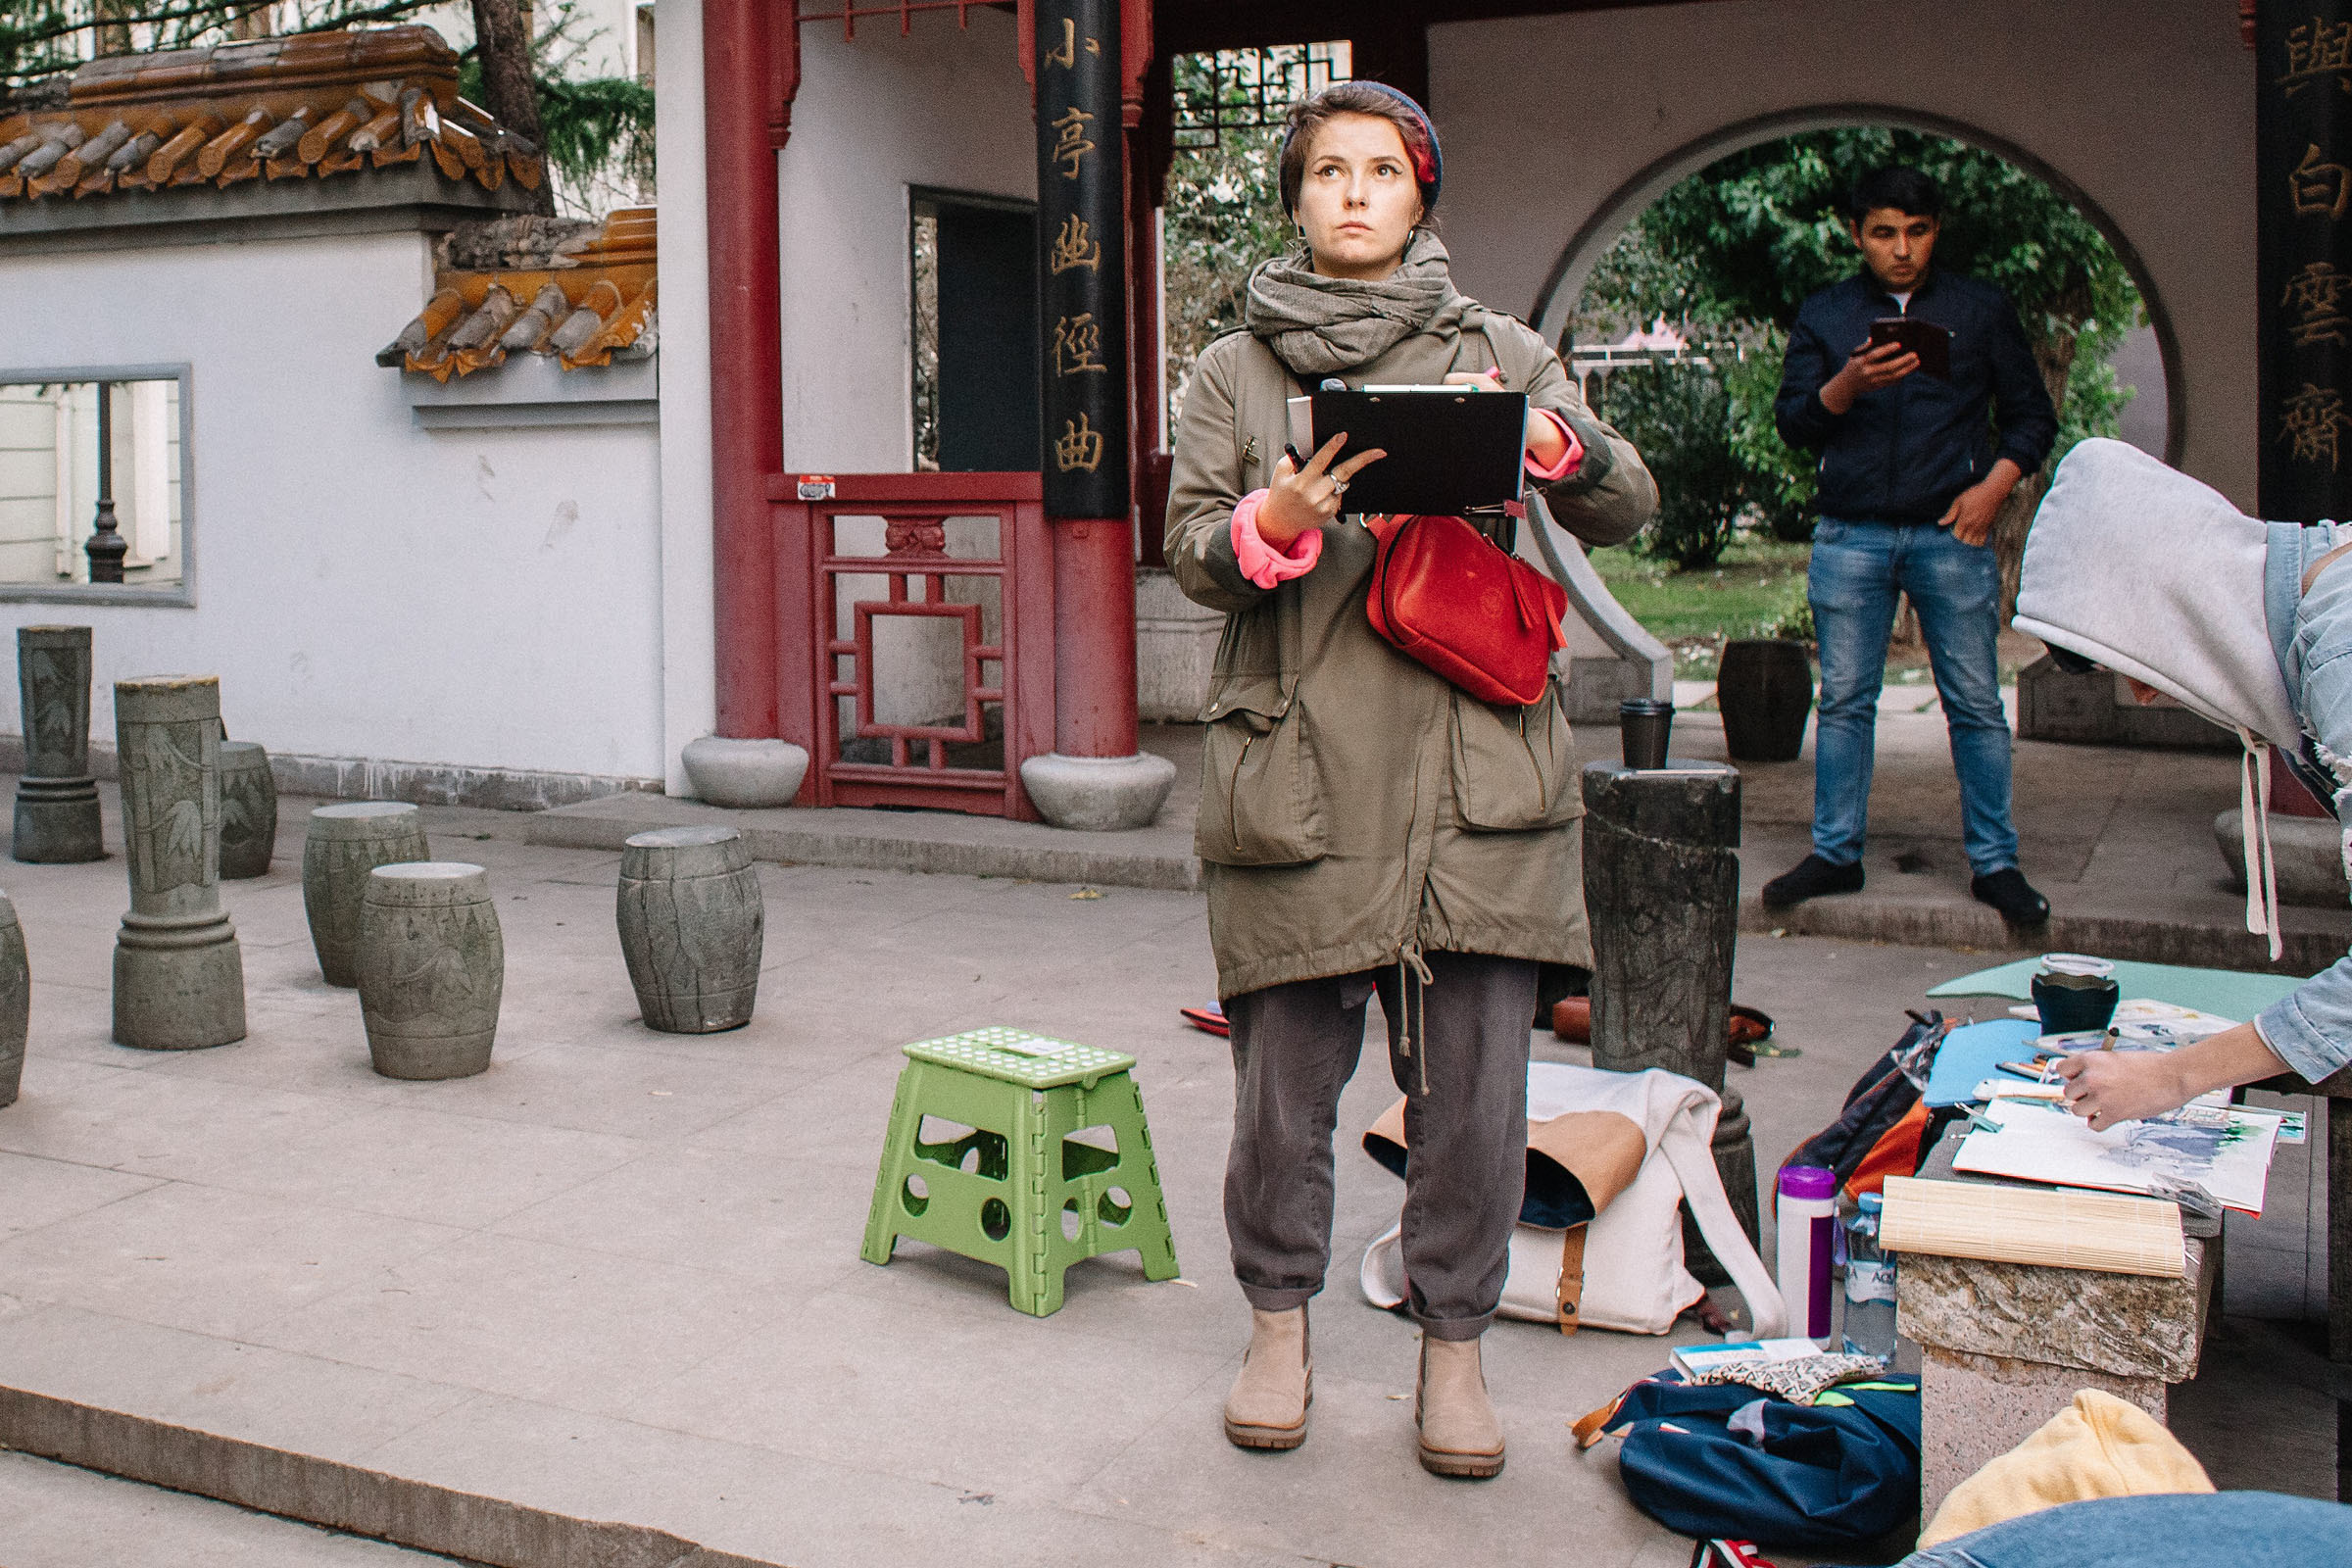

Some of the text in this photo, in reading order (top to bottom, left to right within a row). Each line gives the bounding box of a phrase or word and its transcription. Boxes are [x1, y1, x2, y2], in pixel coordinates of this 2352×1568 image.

[1043, 17, 1108, 474] 小亭幽徑曲
